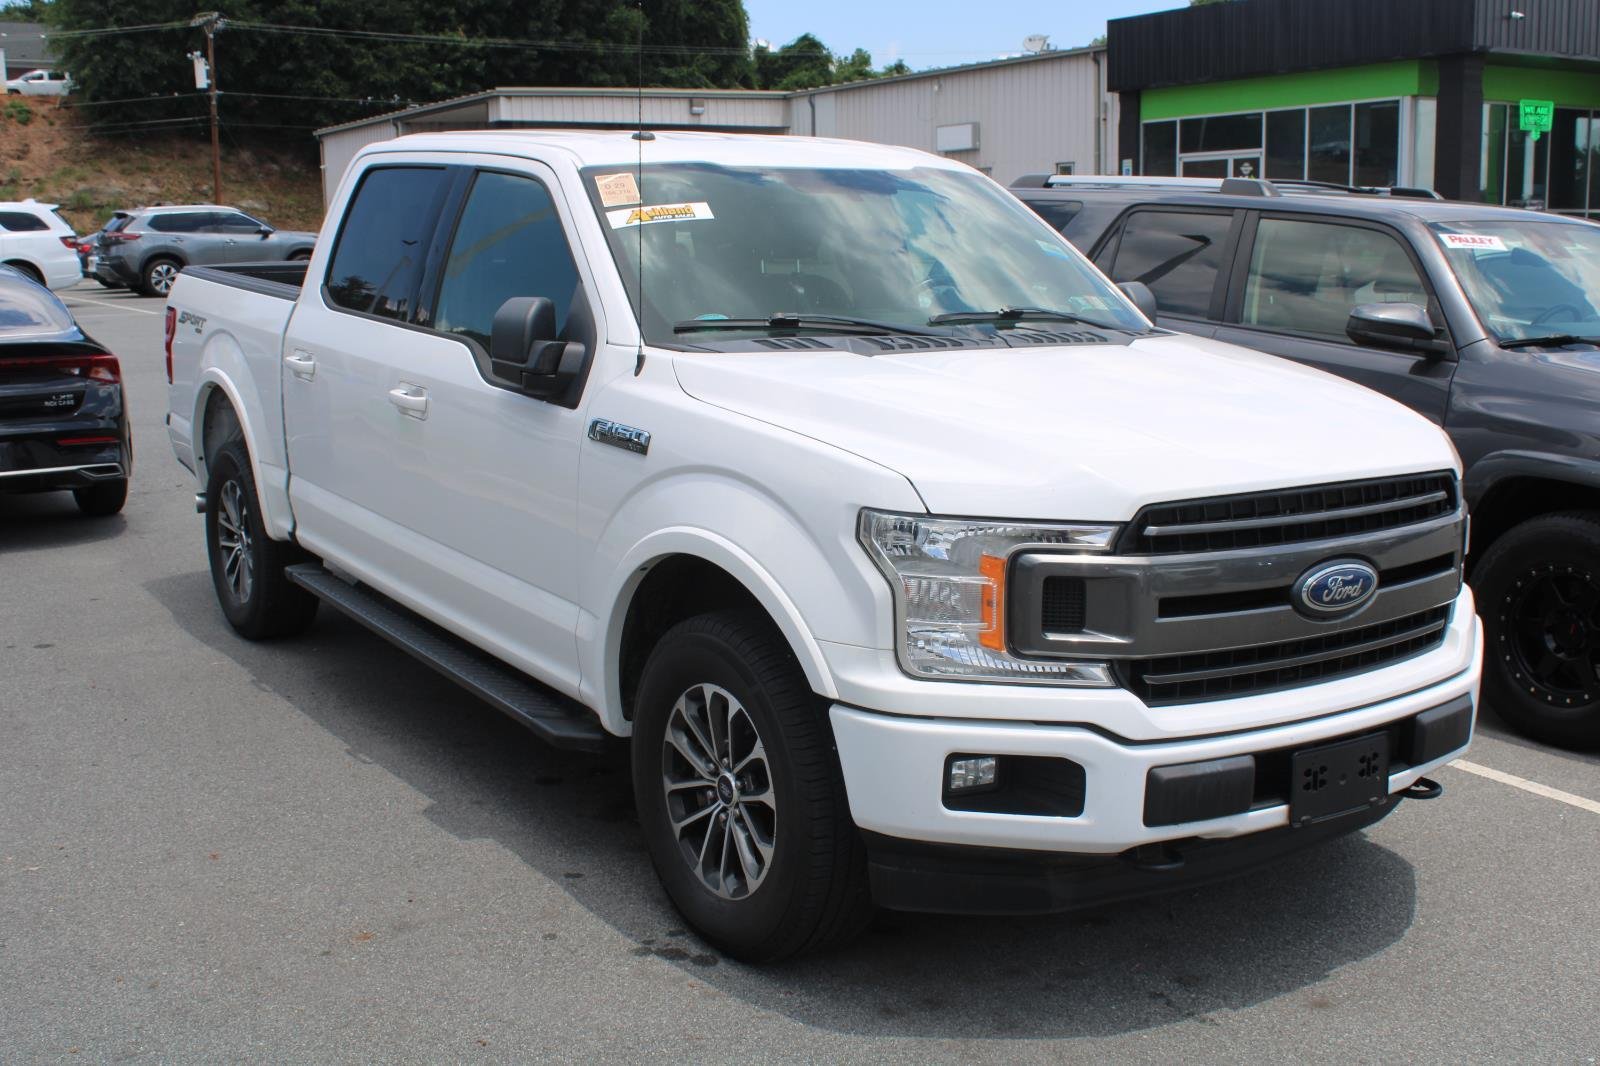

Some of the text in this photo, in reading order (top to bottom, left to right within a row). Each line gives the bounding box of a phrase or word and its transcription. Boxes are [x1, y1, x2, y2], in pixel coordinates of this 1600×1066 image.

[626, 204, 694, 224] Ashland
[178, 310, 207, 329] SPORT
[1322, 574, 1363, 602] Ford
